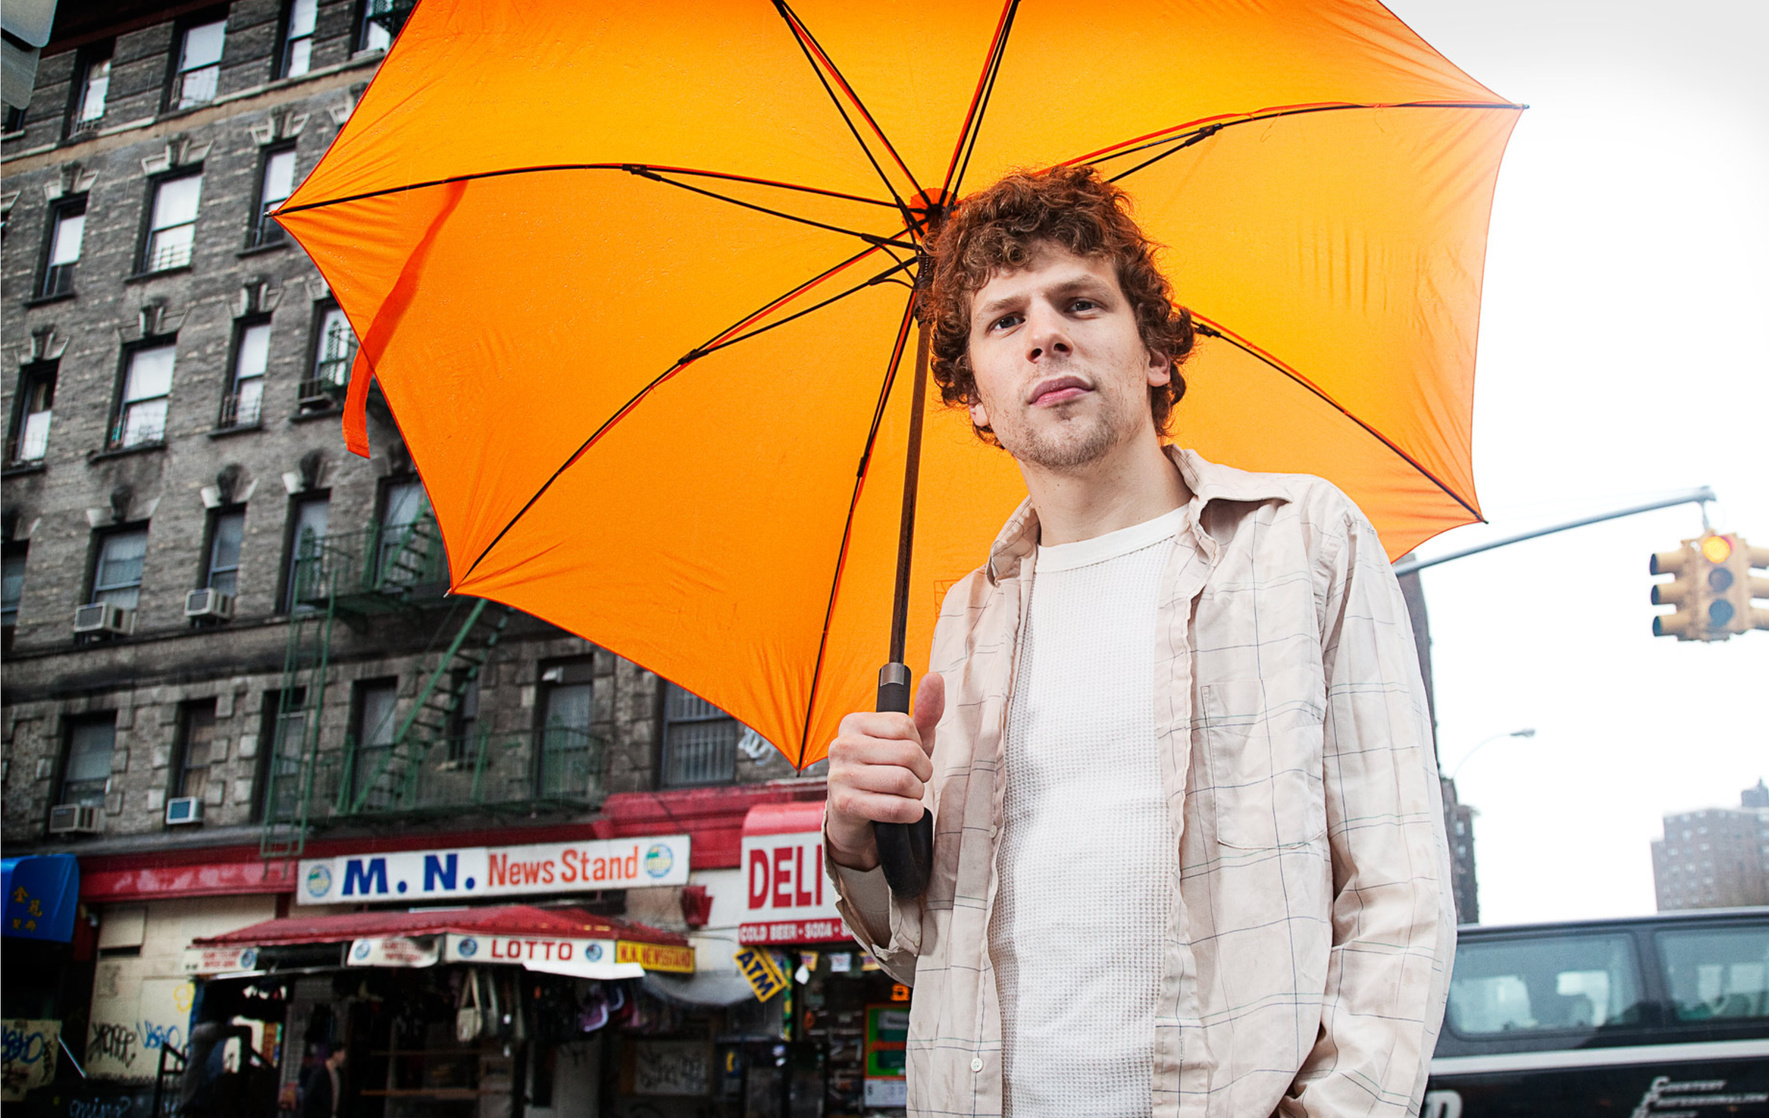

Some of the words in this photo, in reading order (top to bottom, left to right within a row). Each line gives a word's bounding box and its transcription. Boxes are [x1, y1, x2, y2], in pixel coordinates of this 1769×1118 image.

[748, 845, 823, 910] DELI
[740, 926, 767, 942] COLD
[769, 924, 797, 941] BEER
[804, 922, 832, 939] SODA
[491, 939, 573, 961] LOTTO
[737, 951, 775, 996] ATM
